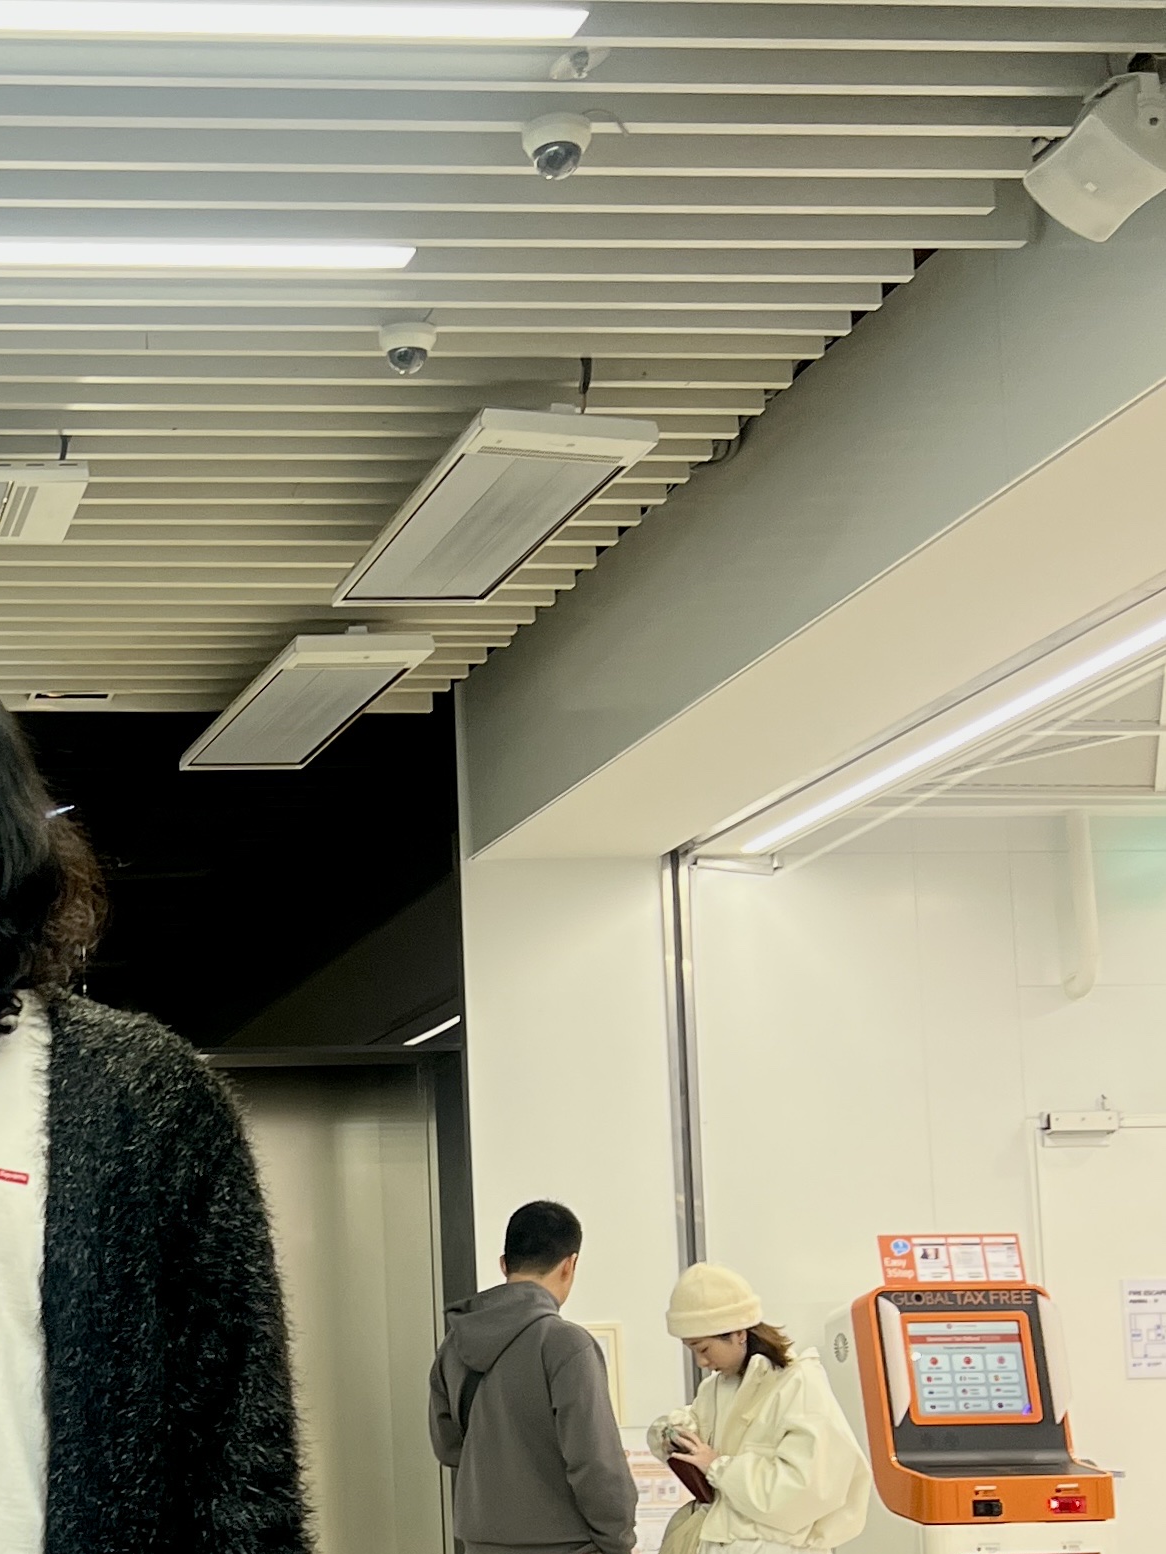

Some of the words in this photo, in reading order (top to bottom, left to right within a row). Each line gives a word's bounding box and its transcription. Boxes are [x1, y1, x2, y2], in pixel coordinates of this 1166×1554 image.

[891, 1292, 953, 1306] GLOBAL
[953, 1291, 988, 1305] TAX
[989, 1290, 1033, 1305] FREE
